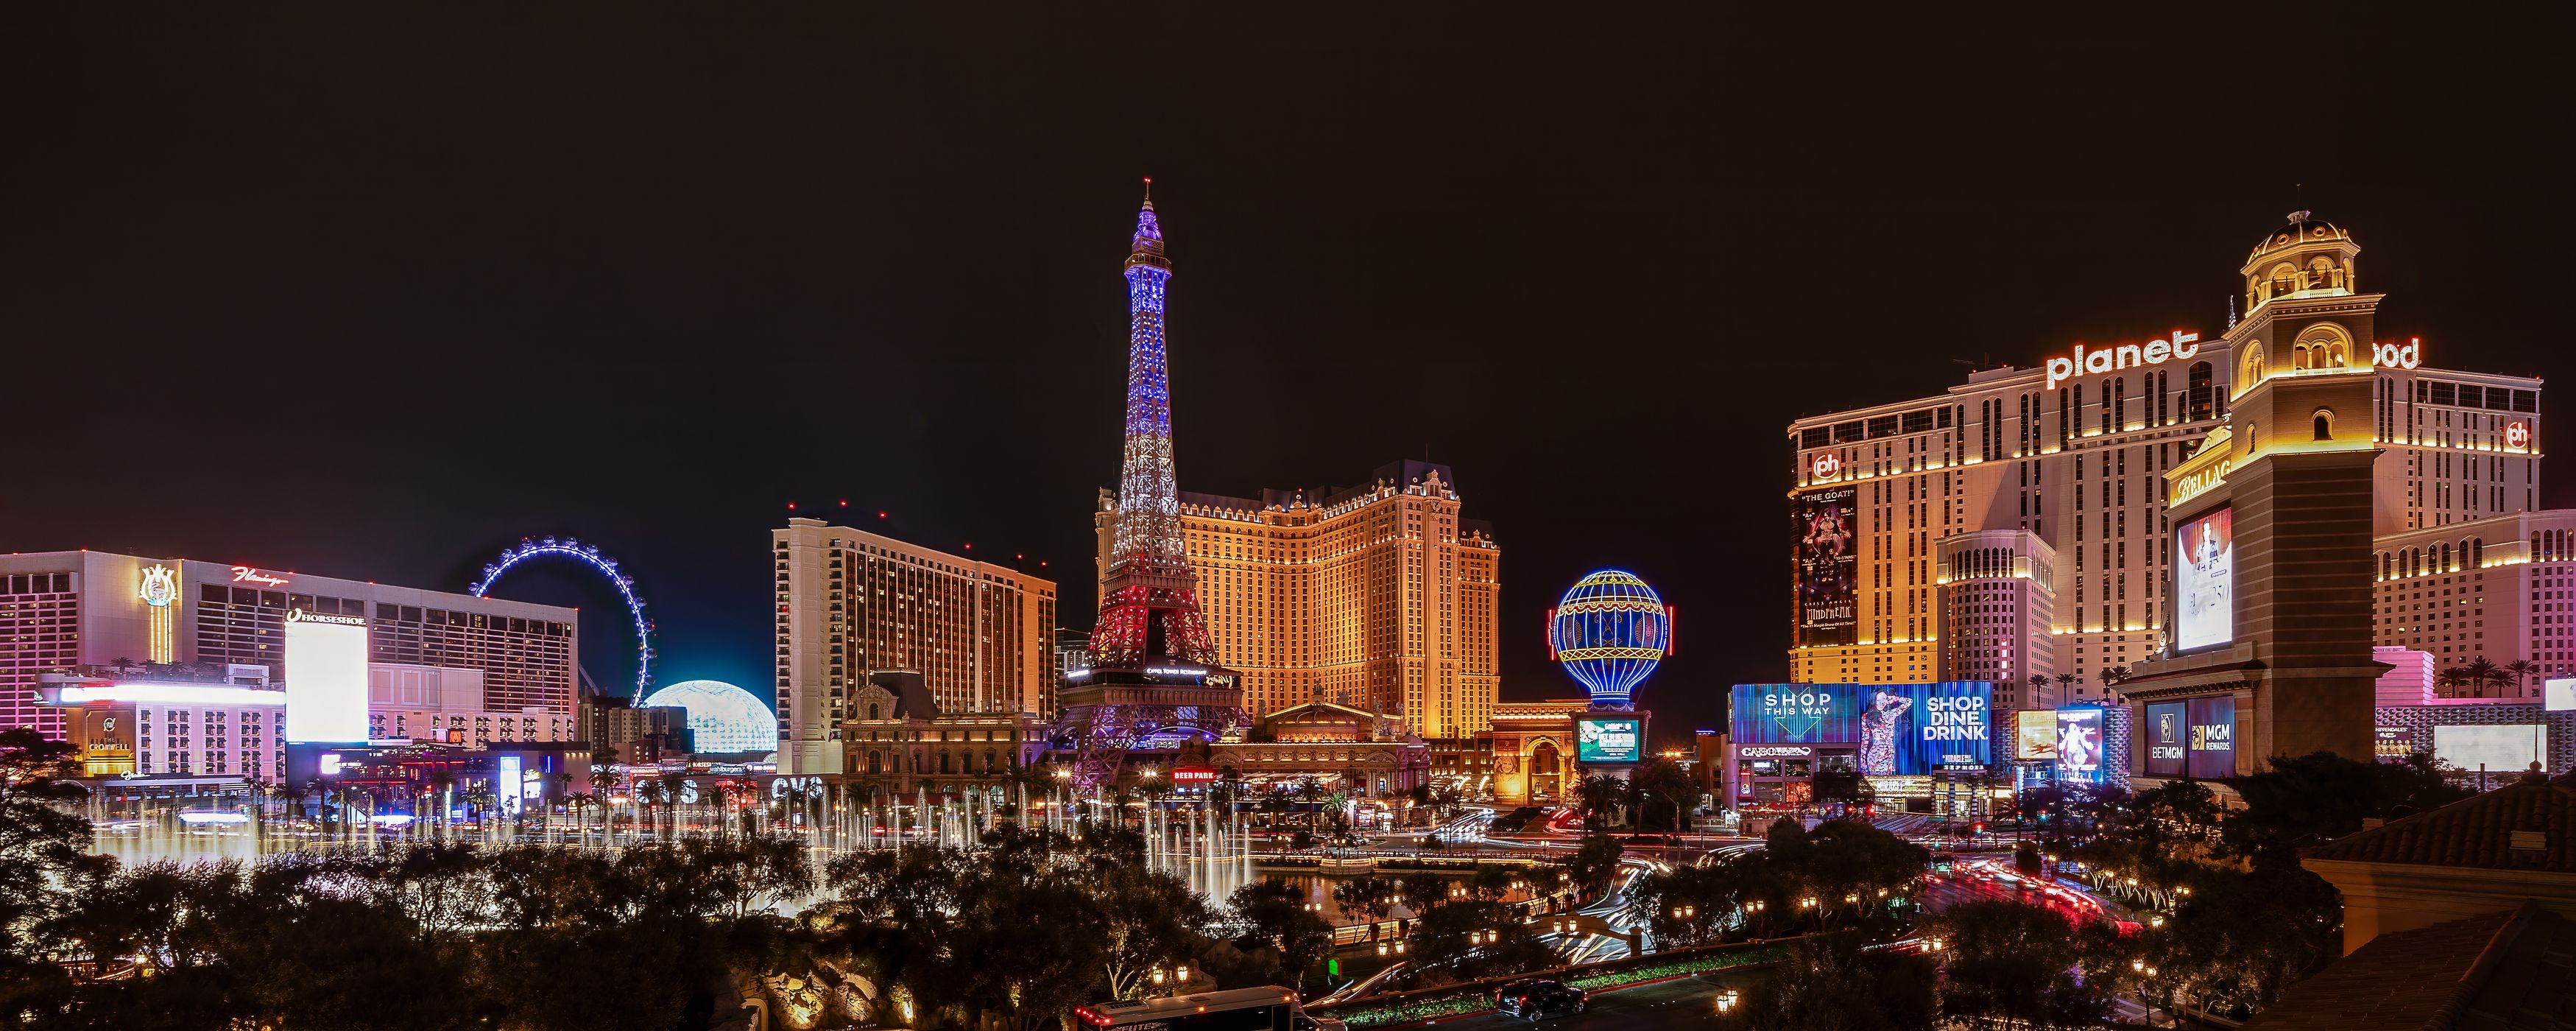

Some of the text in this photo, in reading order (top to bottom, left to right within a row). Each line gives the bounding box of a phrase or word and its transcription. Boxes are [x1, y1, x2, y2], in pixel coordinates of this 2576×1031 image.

[2047, 331, 2199, 390] planet
[1816, 454, 1839, 476] ph
[231, 566, 289, 588] Flamingo
[301, 613, 367, 626] HORSESHOE
[1765, 693, 1831, 706] SHOP
[1927, 696, 1986, 711] SHOP.
[1765, 707, 1830, 715] THIS WAY
[1931, 711, 1983, 726] DINE.
[1924, 725, 1989, 741] DRINK.
[2206, 724, 2230, 741] MGM
[2152, 746, 2184, 759] BETMGM
